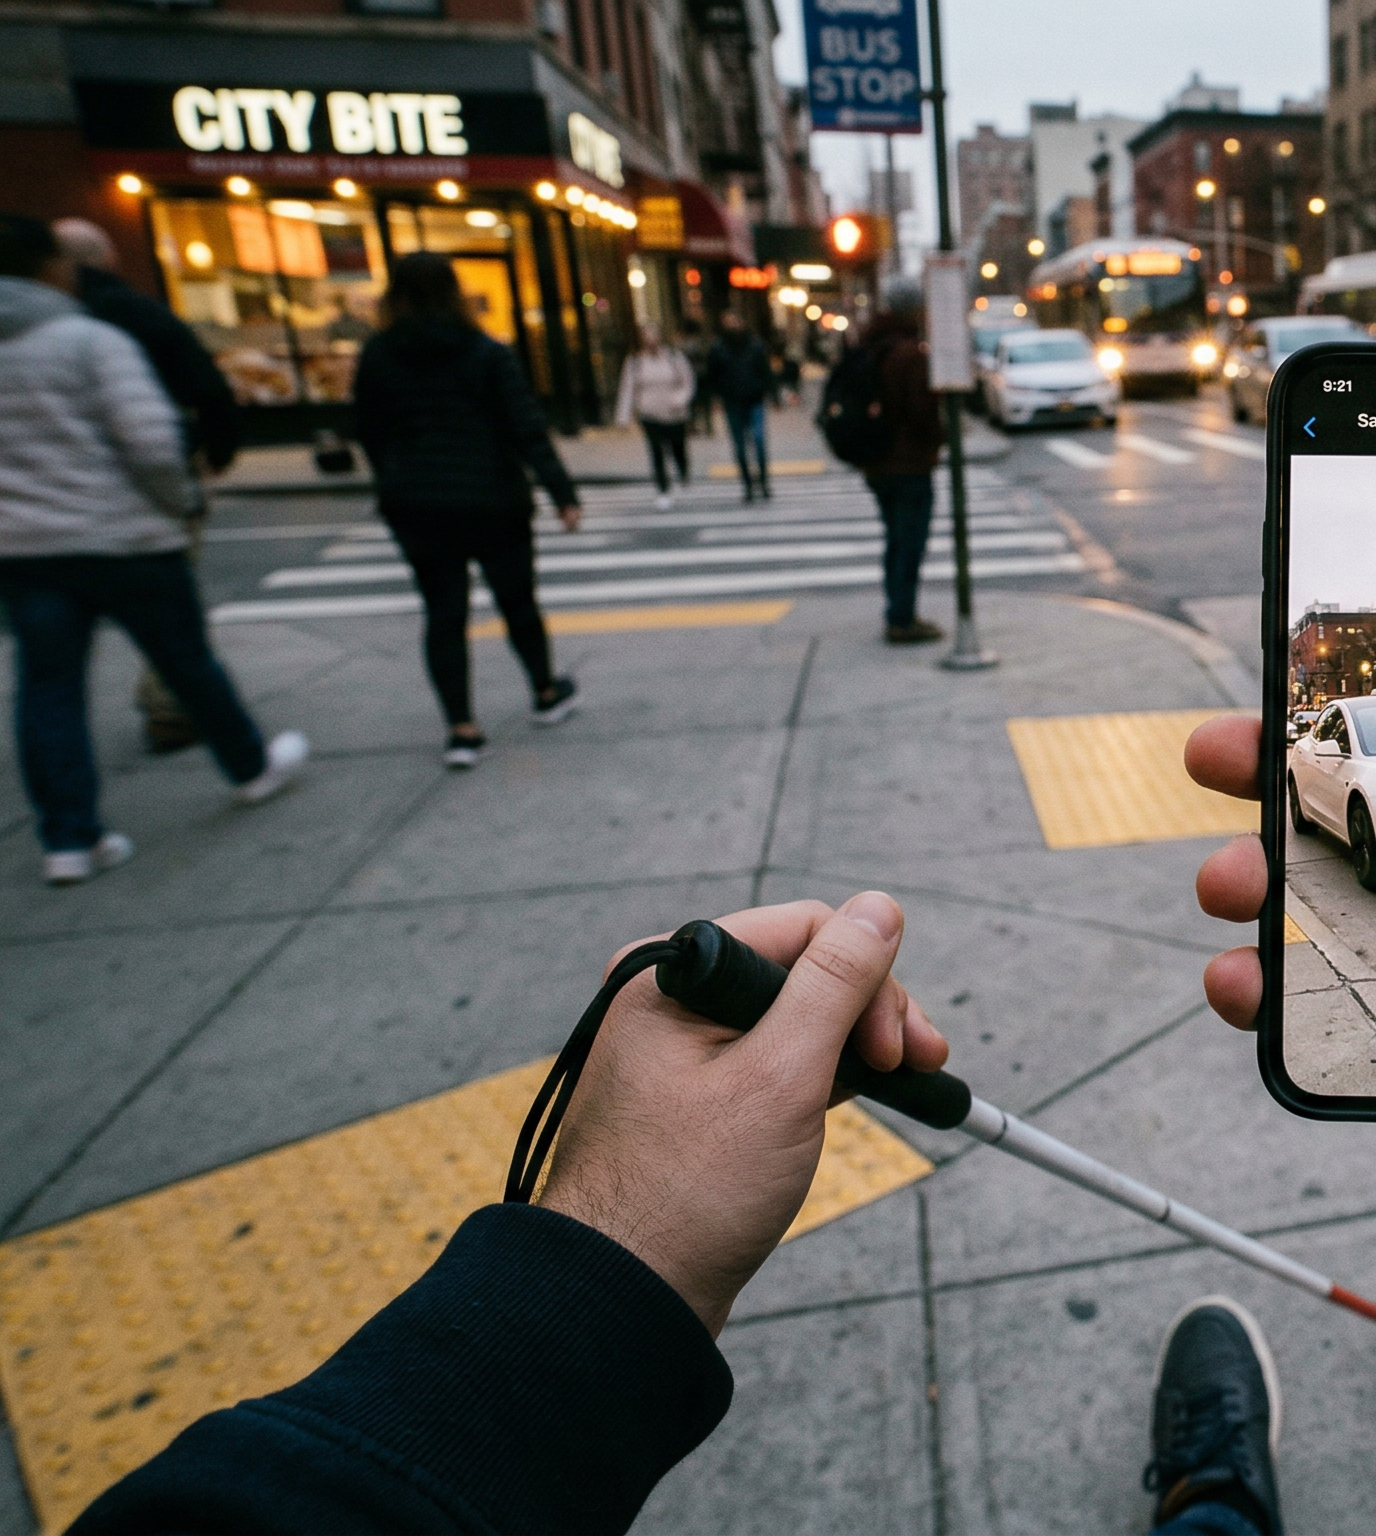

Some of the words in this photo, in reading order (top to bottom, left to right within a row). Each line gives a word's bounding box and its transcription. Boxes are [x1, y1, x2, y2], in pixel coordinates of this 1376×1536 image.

[820, 26, 901, 64] BUS
[812, 66, 915, 104] STOP
[173, 86, 315, 152] CITY
[326, 91, 469, 155] BITE
[1323, 380, 1352, 392] 9:21
